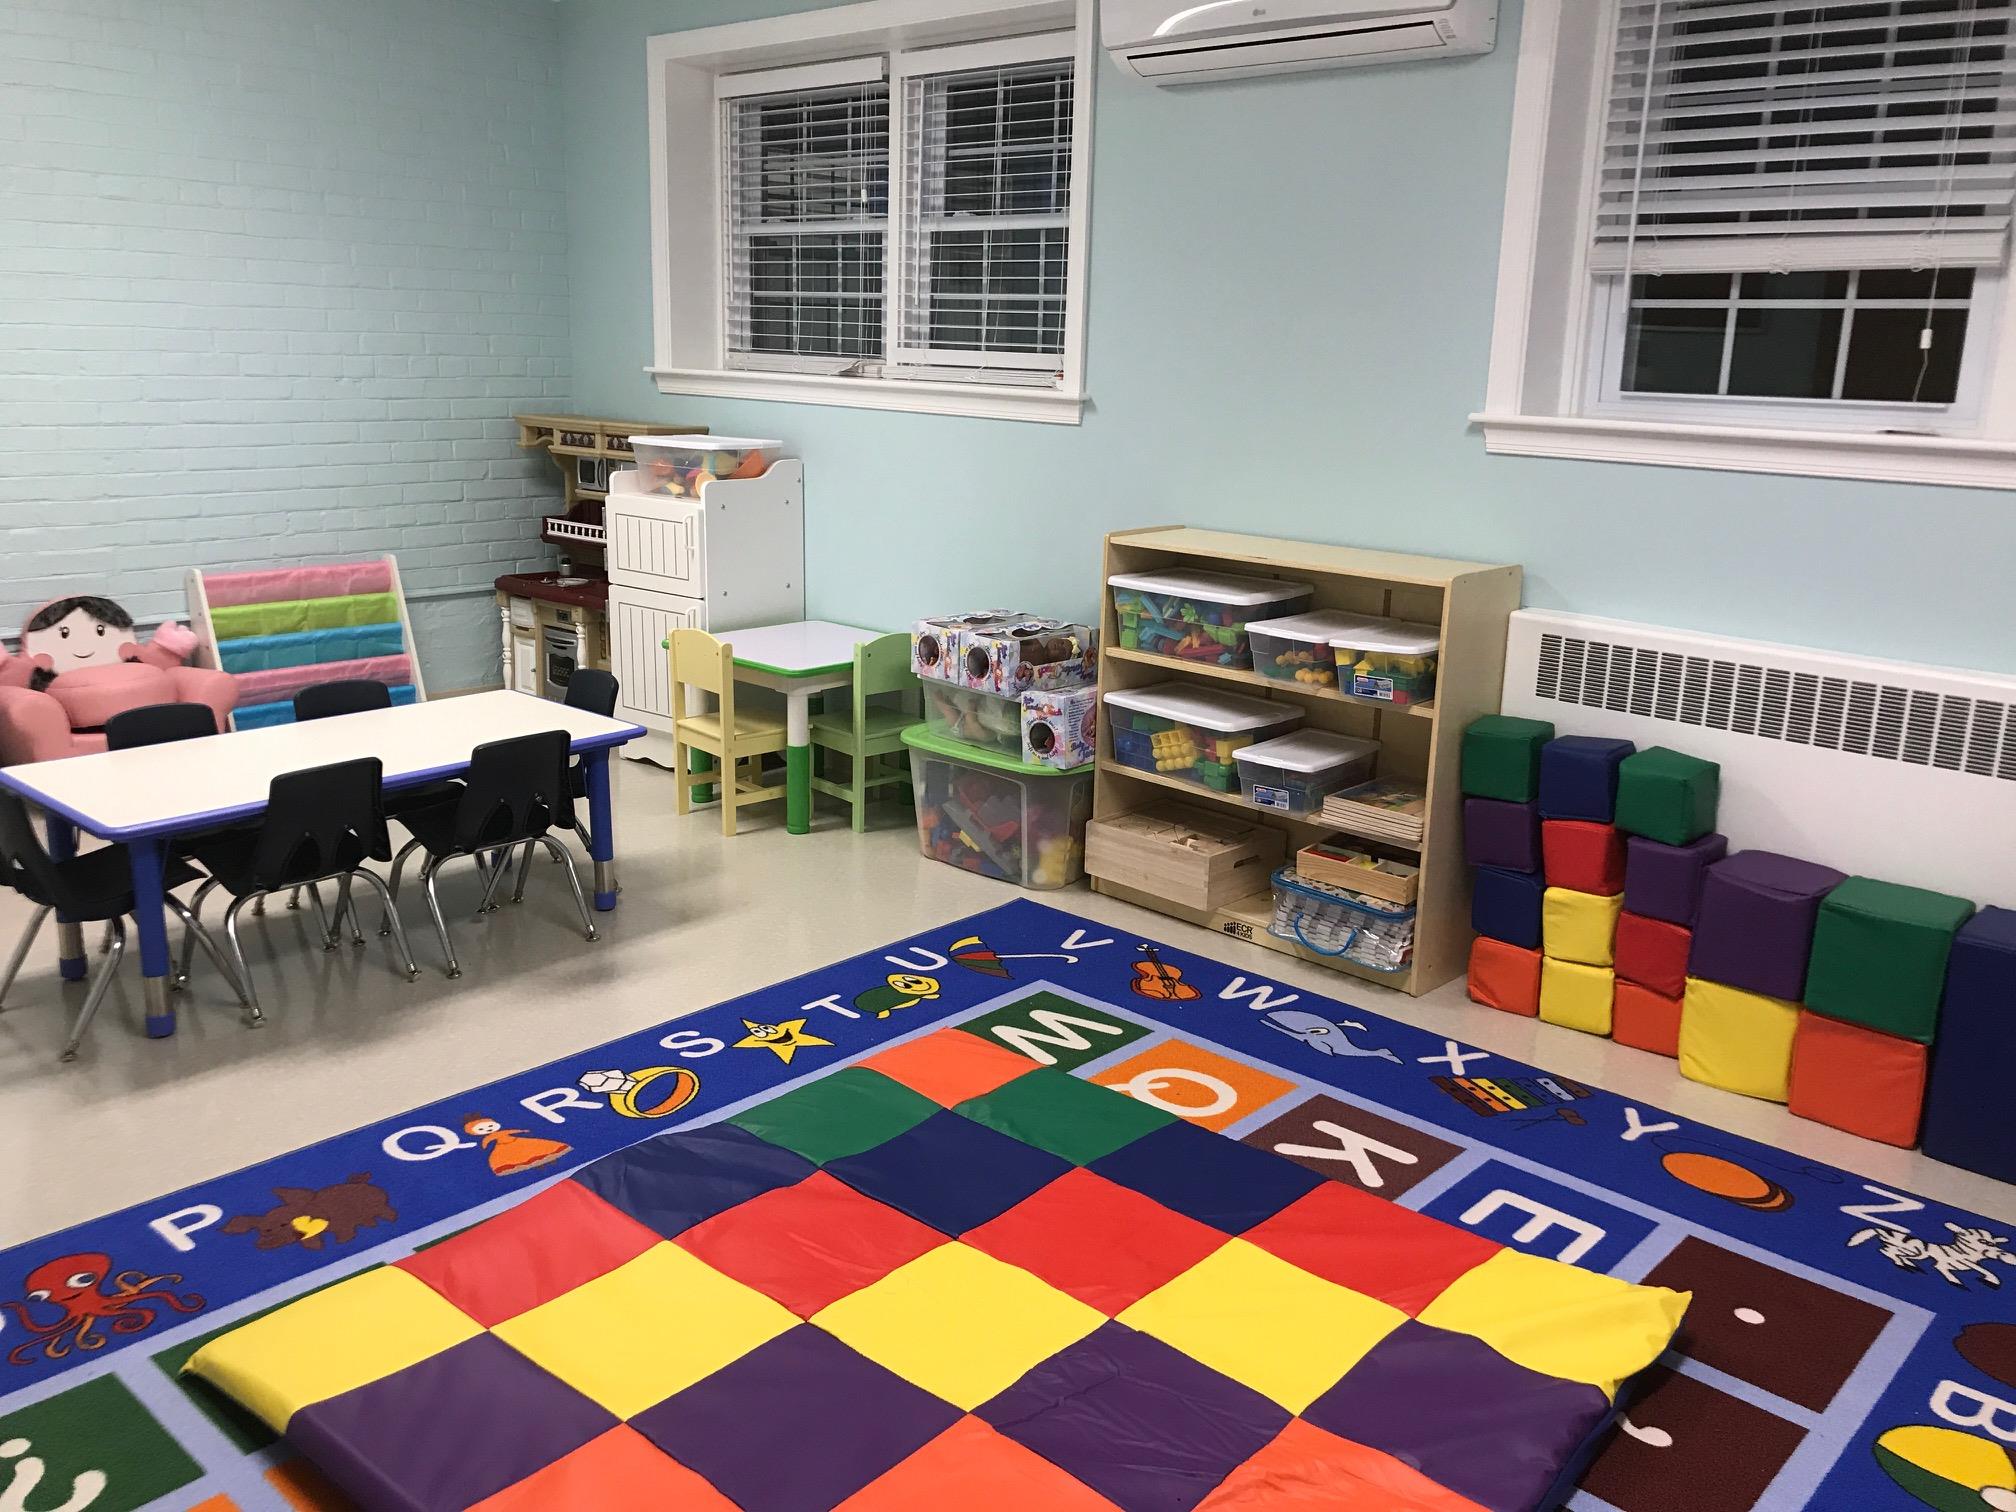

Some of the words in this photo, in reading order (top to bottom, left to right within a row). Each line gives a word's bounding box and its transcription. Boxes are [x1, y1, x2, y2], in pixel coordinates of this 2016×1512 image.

[1236, 922, 1254, 935] ECR
[1061, 928, 1115, 951] V
[1218, 976, 1299, 1011] W
[1417, 1040, 1490, 1076] X
[1620, 1106, 1680, 1141] Y
[148, 1203, 223, 1252] P
[381, 1124, 478, 1161] Q
[519, 1086, 603, 1124] R
[659, 1030, 726, 1059] S
[800, 993, 862, 1019] T
[884, 946, 949, 972] U
[1104, 1067, 1238, 1118] Q
[1272, 1119, 1419, 1189] K
[1459, 1188, 1608, 1265] E
[1928, 1379, 2016, 1443] B
